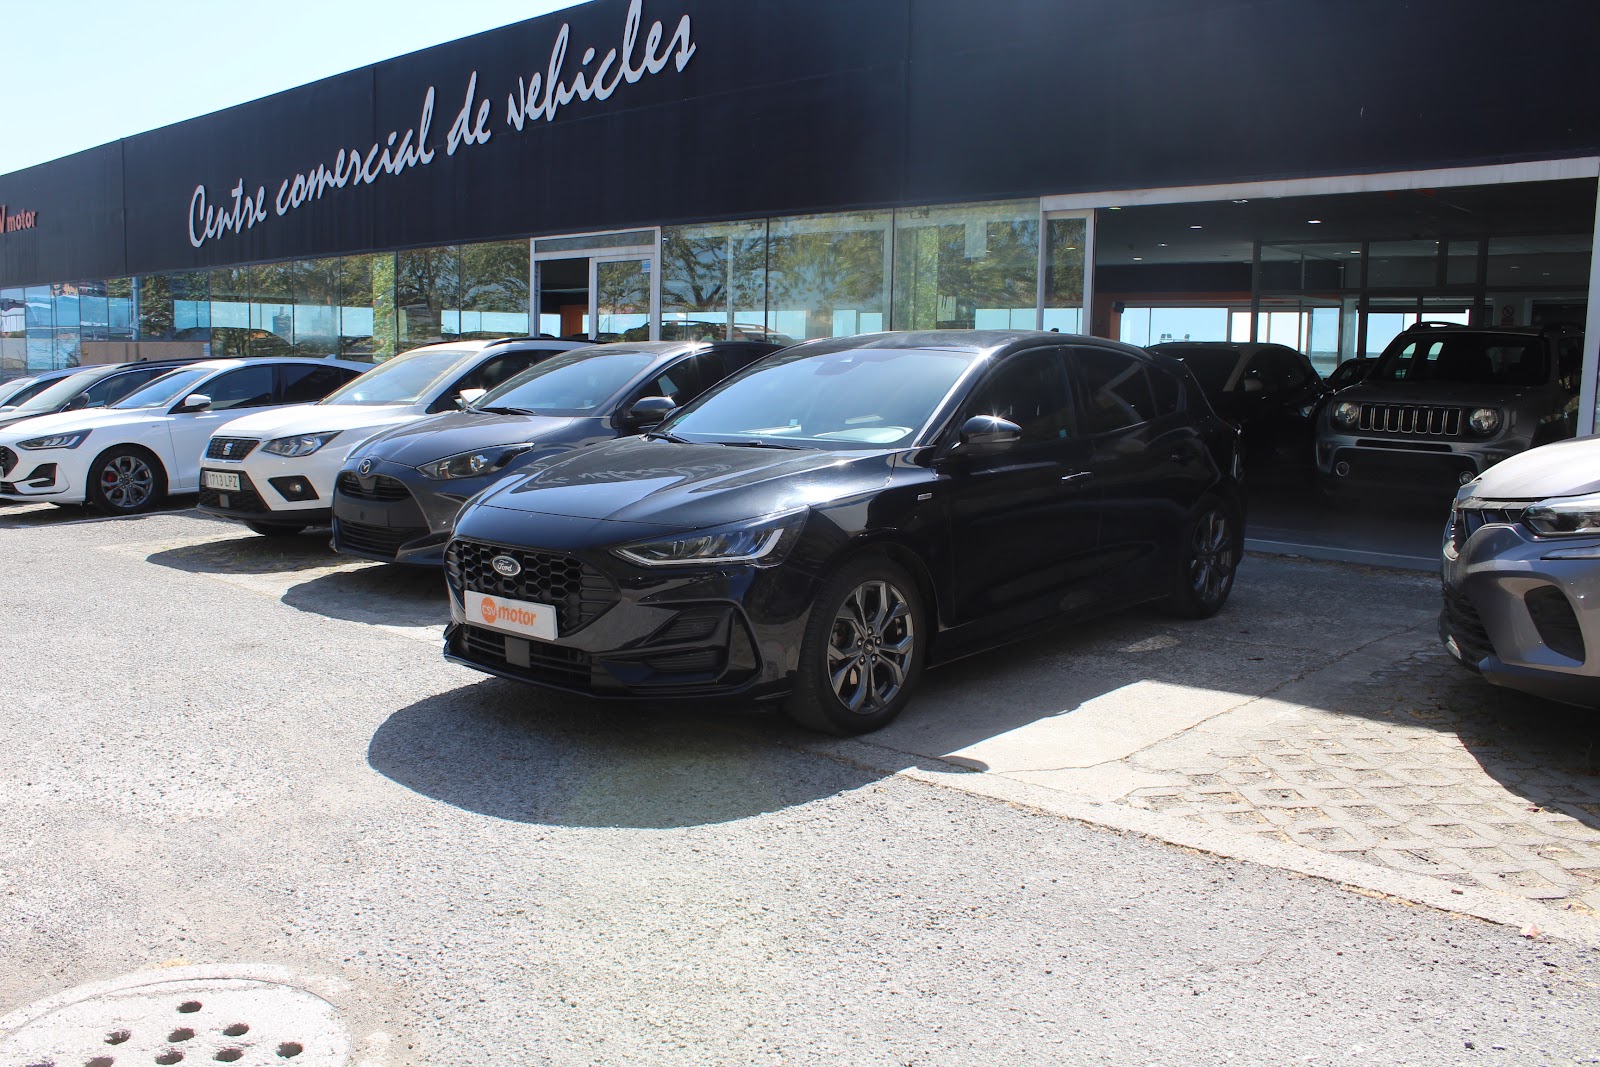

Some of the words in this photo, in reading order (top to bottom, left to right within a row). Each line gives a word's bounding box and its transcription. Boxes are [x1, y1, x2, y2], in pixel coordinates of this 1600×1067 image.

[189, 185, 267, 247] Centre
[275, 86, 435, 216] comercial
[447, 71, 491, 156] de
[508, 0, 696, 131] vehicles
[7, 209, 36, 232] motor
[497, 559, 513, 572] Ford
[498, 606, 537, 626] motor
